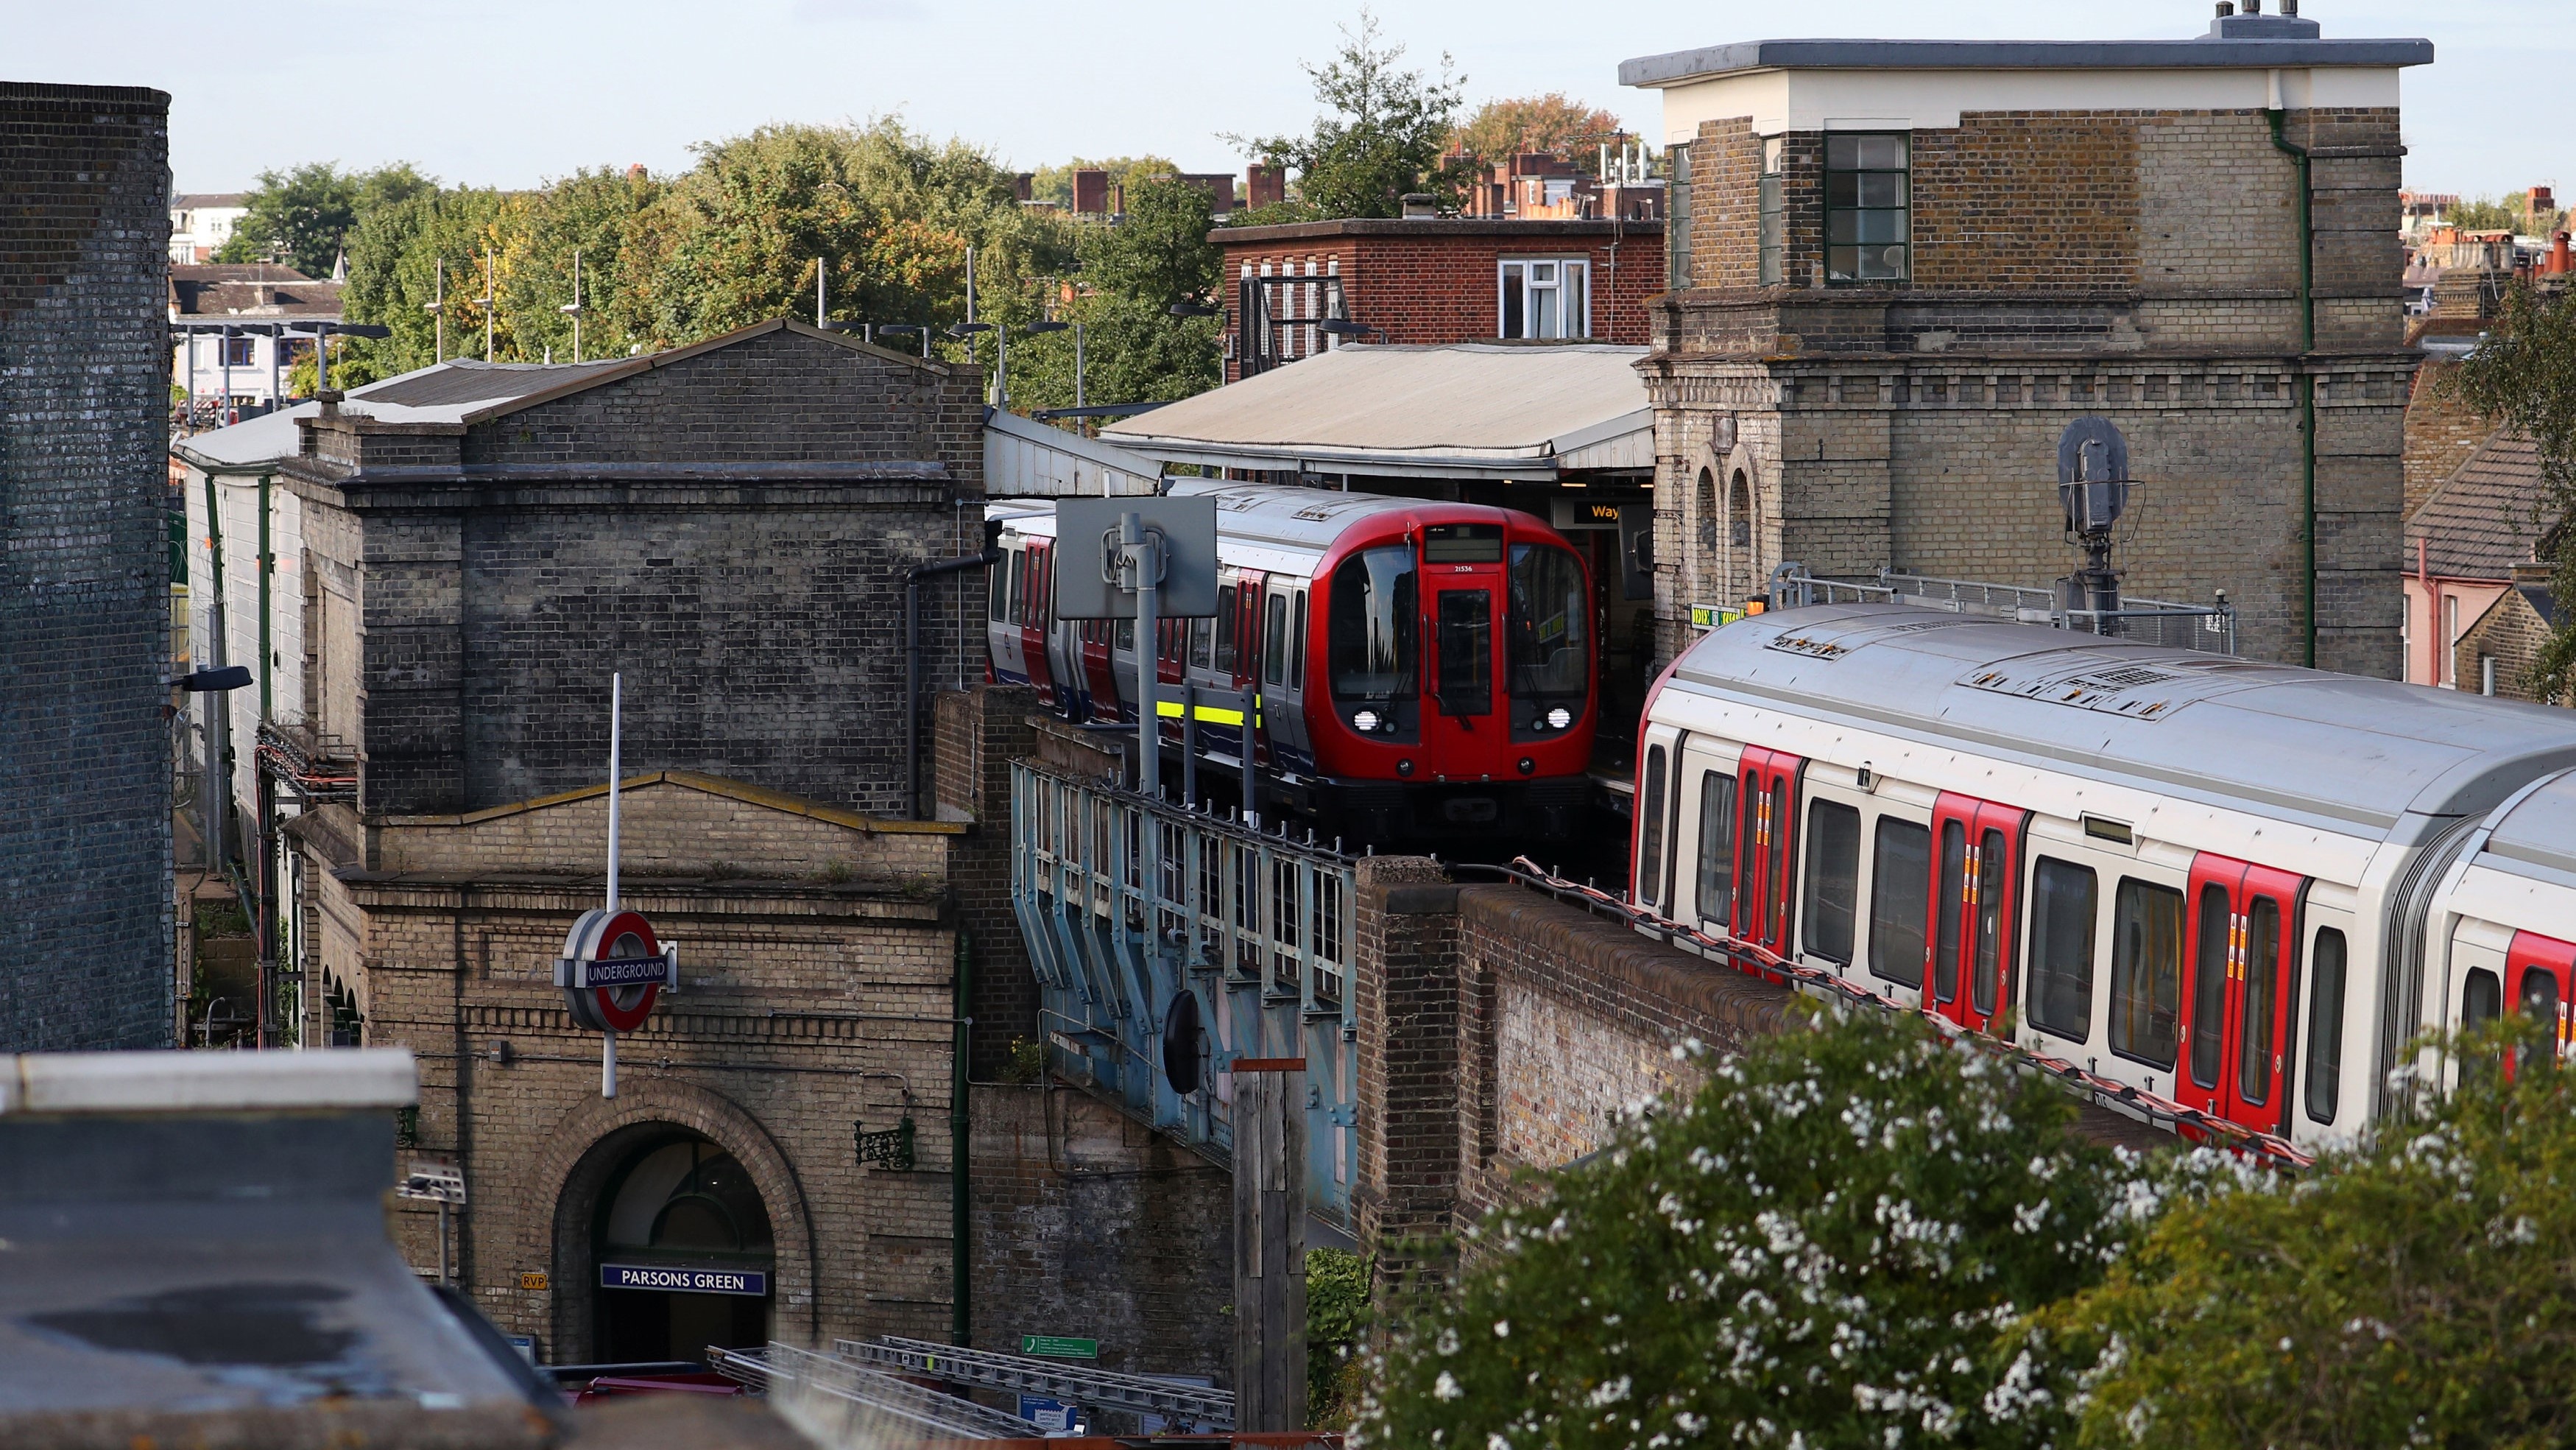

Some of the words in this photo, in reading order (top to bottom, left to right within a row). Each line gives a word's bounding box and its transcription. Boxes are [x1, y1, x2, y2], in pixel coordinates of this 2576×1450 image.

[1591, 505, 1619, 520] Way
[588, 962, 666, 982] UNDERGROUND
[523, 1275, 545, 1287] RVP
[621, 1270, 691, 1287] PARSONS
[694, 1273, 745, 1290] GREEN
